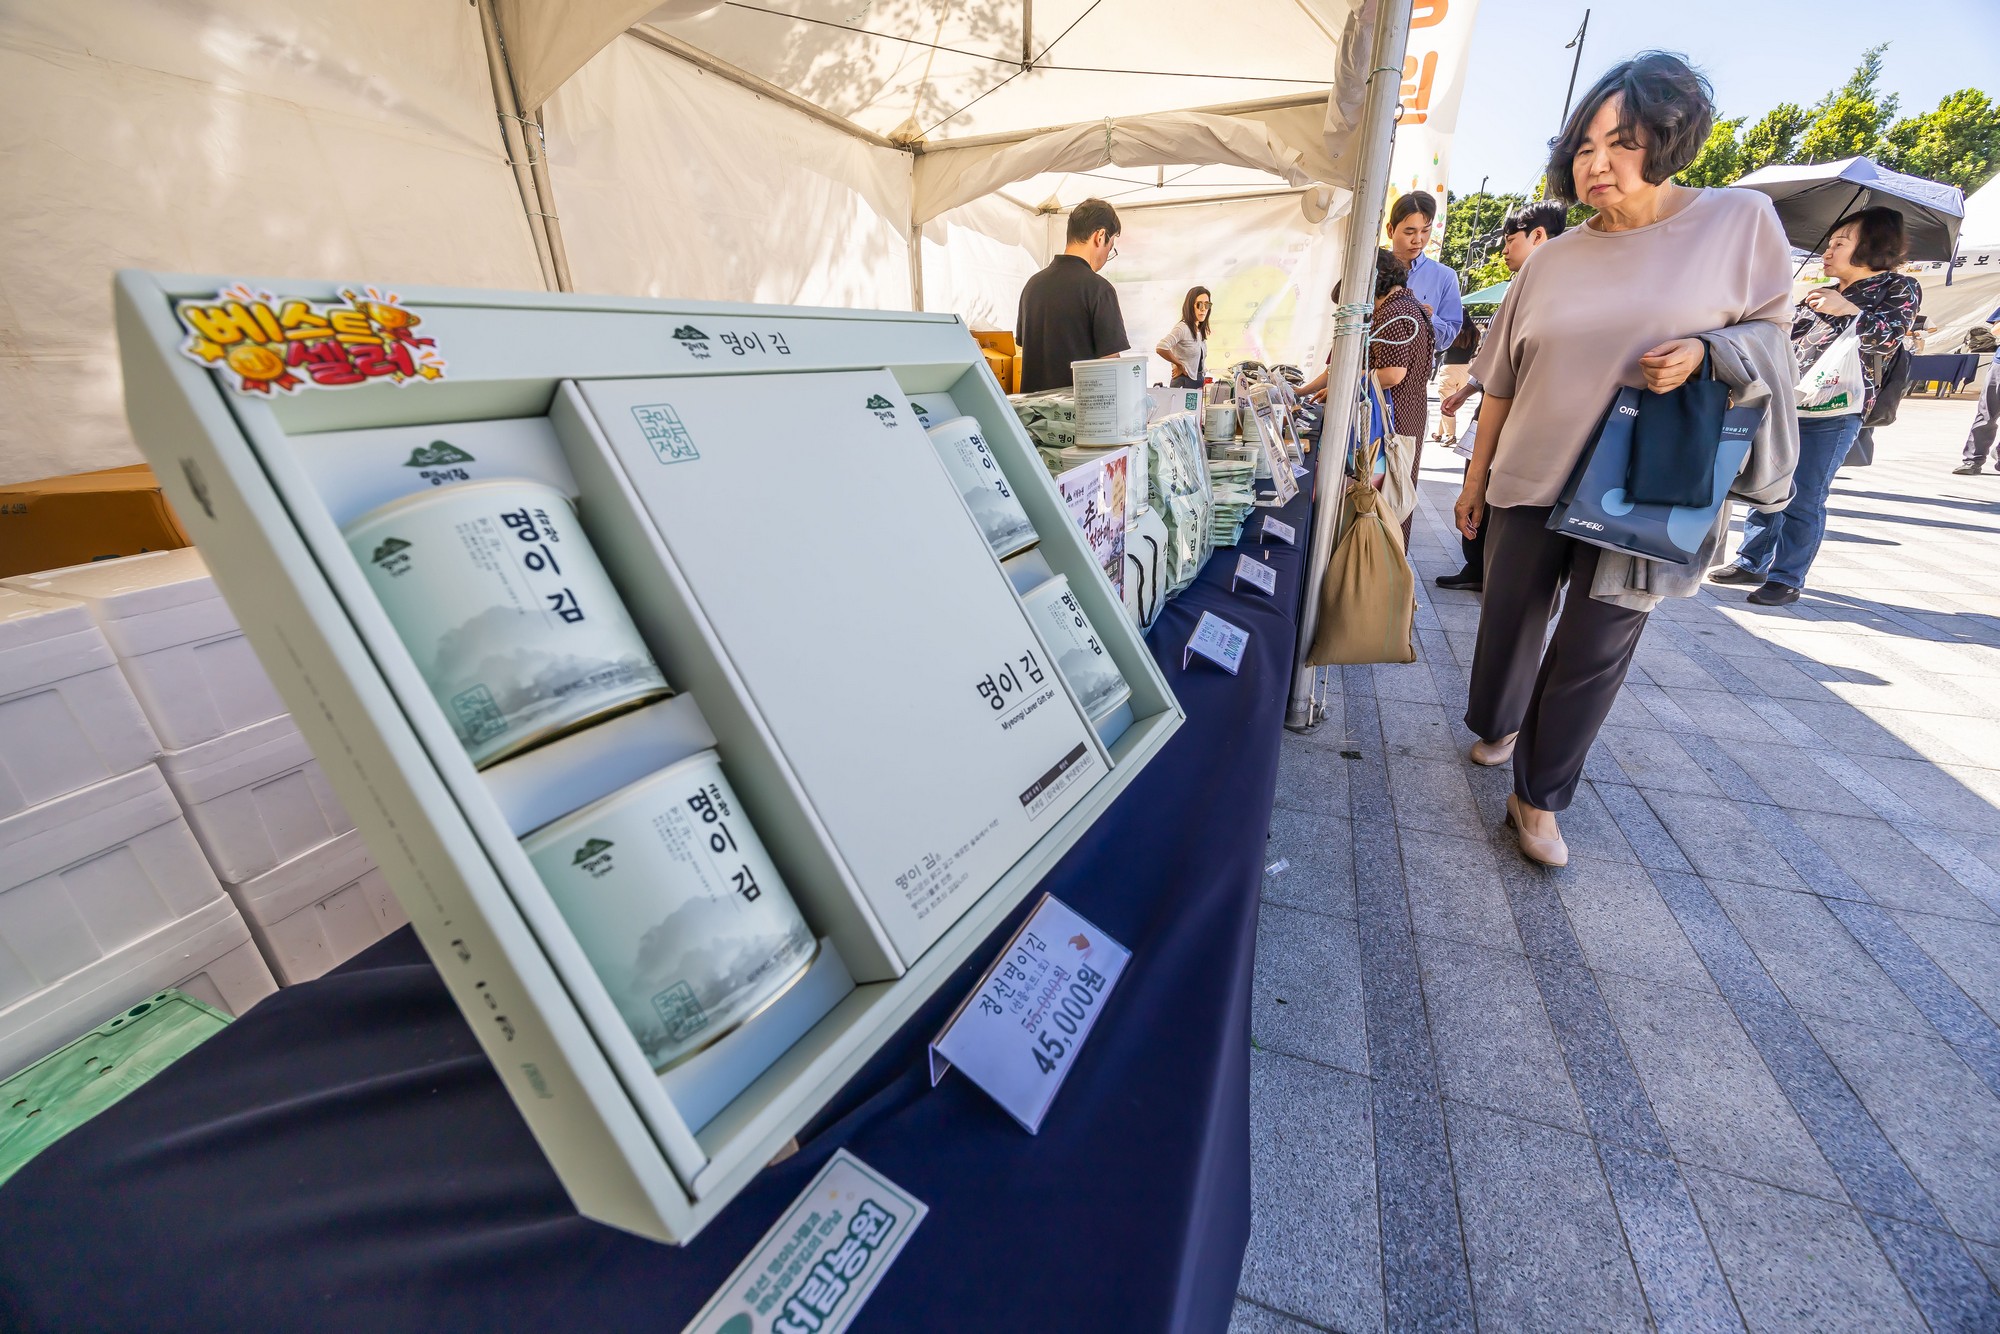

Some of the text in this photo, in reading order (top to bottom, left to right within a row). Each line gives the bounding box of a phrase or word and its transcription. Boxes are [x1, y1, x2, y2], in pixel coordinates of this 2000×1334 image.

[184, 302, 383, 344] 베스트
[719, 331, 791, 355] 명이 김
[287, 340, 415, 385] 셀러
[970, 432, 998, 472] 명이
[995, 479, 1010, 498] 김
[1058, 434, 1075, 444] 명이
[500, 507, 562, 576] 명이
[547, 588, 584, 624] 김
[1061, 592, 1088, 629] 명이
[1088, 636, 1102, 656] 김
[976, 649, 1044, 710] 명이 김
[1001, 689, 1055, 731] Myeongi Laver Gift Set
[687, 787, 761, 902] 명이 김
[895, 863, 922, 890] 명이
[979, 931, 1047, 1016] 정선명이김
[1021, 965, 1071, 1034] 55,000원
[1031, 963, 1106, 1075] 45,000원
[772, 1199, 896, 1334] 서림농원
